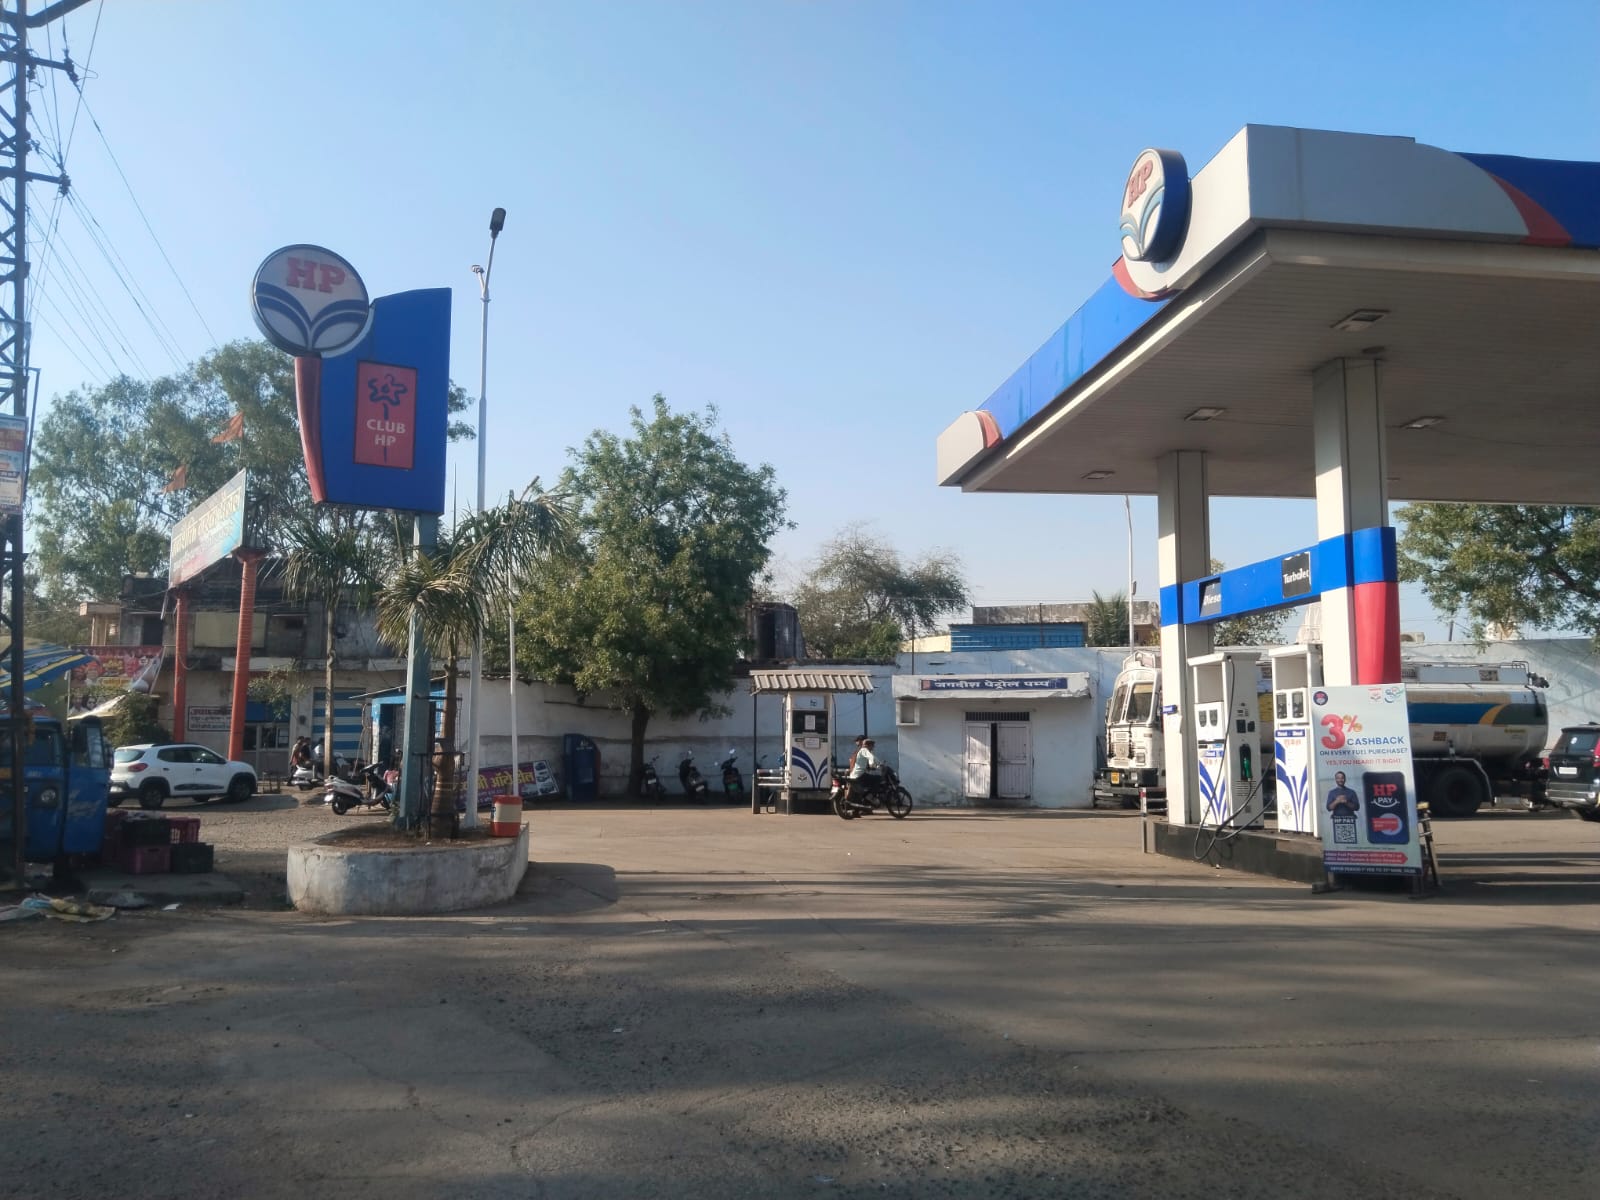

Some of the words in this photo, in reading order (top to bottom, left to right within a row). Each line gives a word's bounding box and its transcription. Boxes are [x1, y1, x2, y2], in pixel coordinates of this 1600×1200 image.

[1128, 160, 1153, 208] HP
[286, 257, 346, 294] HP
[366, 418, 406, 434] CLUB
[375, 434, 396, 446] HP
[934, 679, 980, 688] जगदीश
[984, 679, 1019, 690] पेट्रोल
[1023, 680, 1050, 688] पम्प
[1321, 714, 1363, 749] 3%
[1347, 736, 1404, 746] CASHBACK
[1373, 783, 1398, 796] HP
